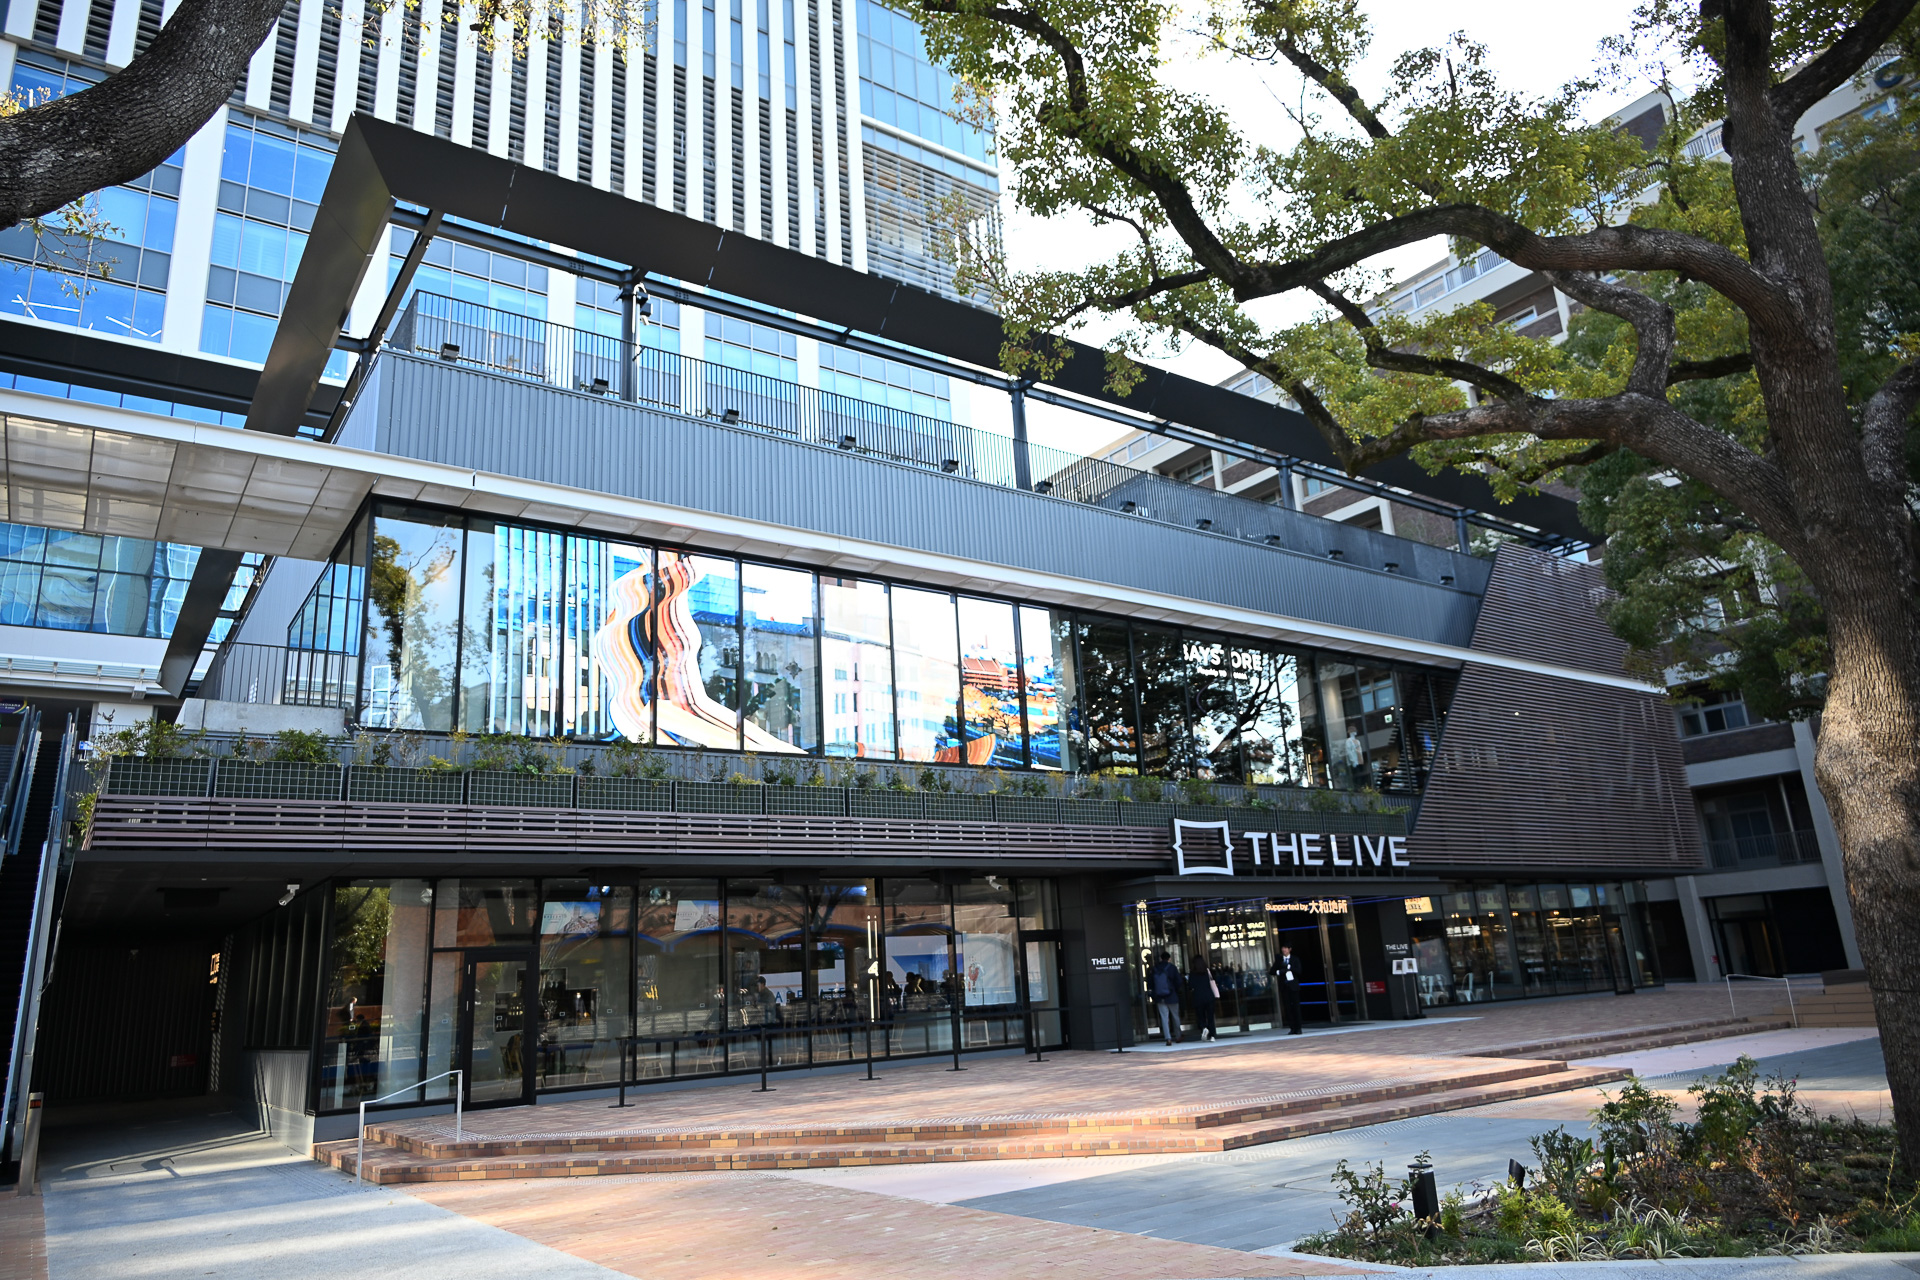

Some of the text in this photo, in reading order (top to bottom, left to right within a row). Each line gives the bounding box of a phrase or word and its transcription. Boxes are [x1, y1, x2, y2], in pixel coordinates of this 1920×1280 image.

[1183, 644, 1262, 671] BAYSORE
[1243, 832, 1410, 867] THE LIVE
[1265, 903, 1299, 912] Supported
[1309, 900, 1348, 914] 大和地所
[1108, 957, 1124, 965] LIVE
